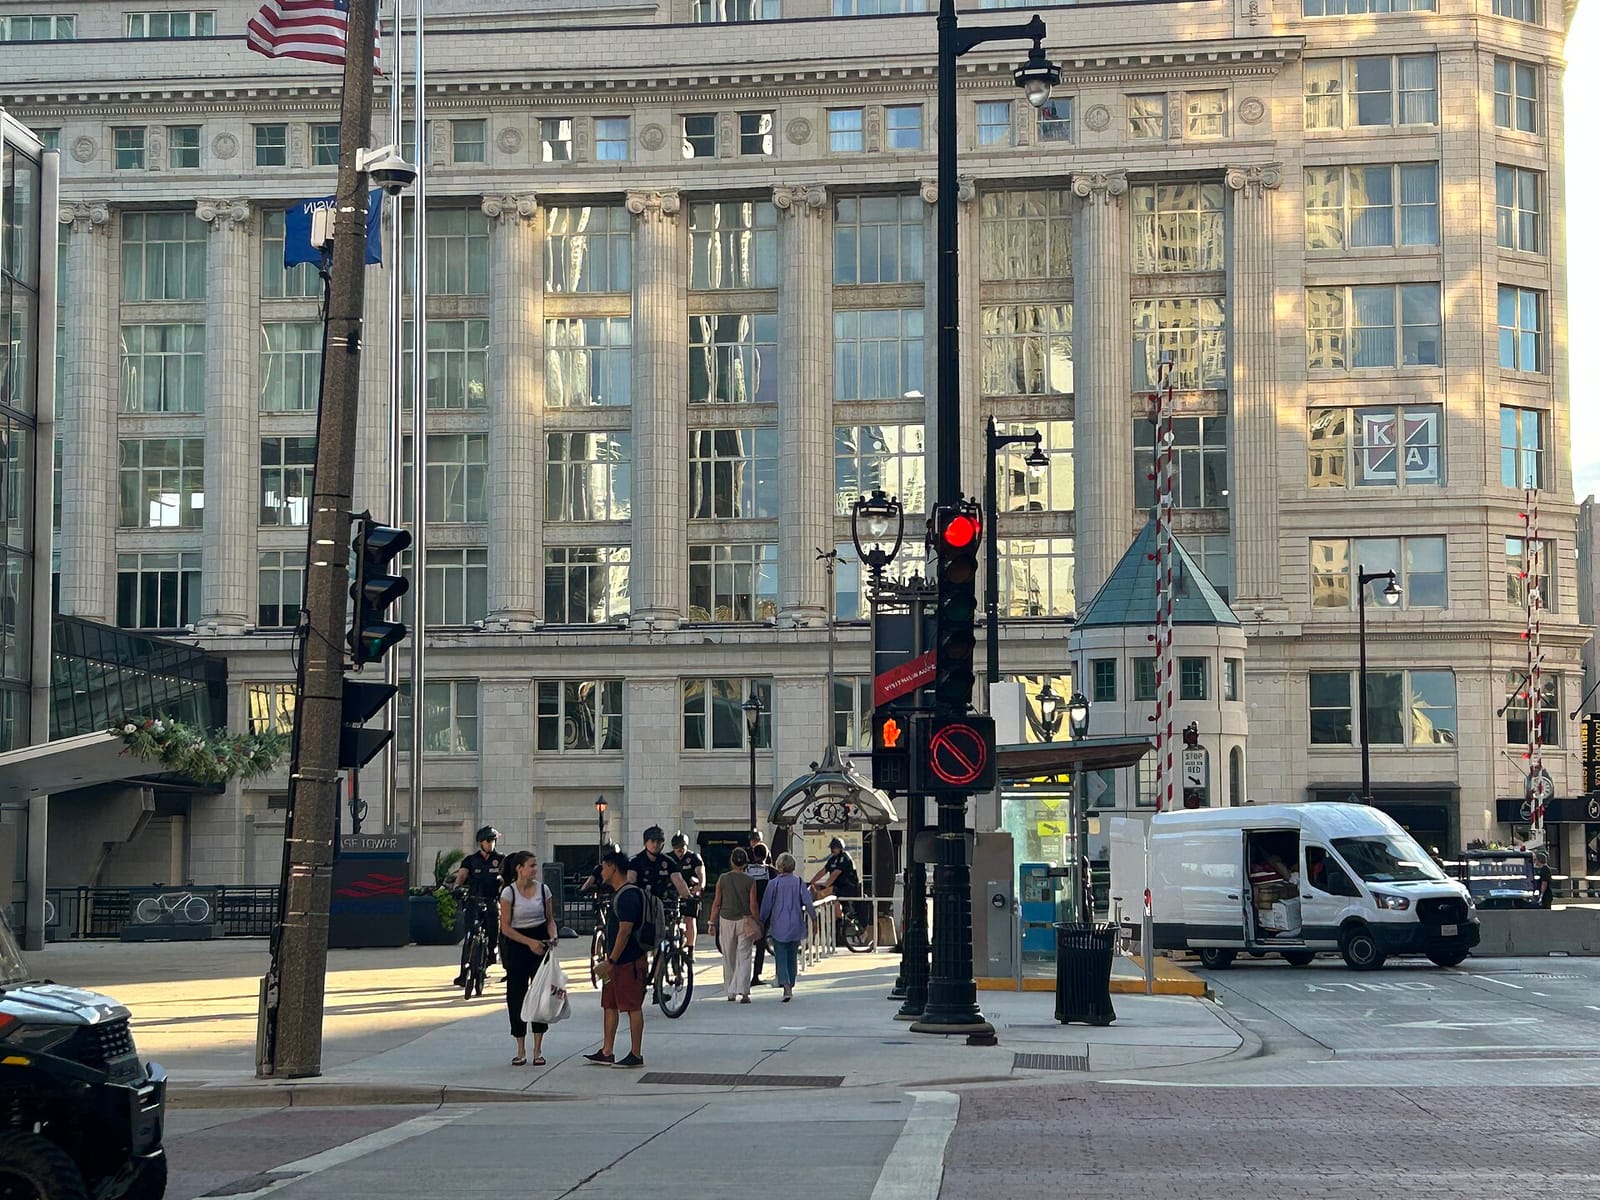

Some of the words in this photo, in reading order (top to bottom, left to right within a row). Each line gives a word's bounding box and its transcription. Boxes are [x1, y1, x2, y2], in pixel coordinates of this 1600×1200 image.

[1373, 424, 1392, 445] K
[1405, 447, 1423, 465] A
[361, 838, 397, 849] TOWER
[1304, 982, 1437, 993] ONLY
